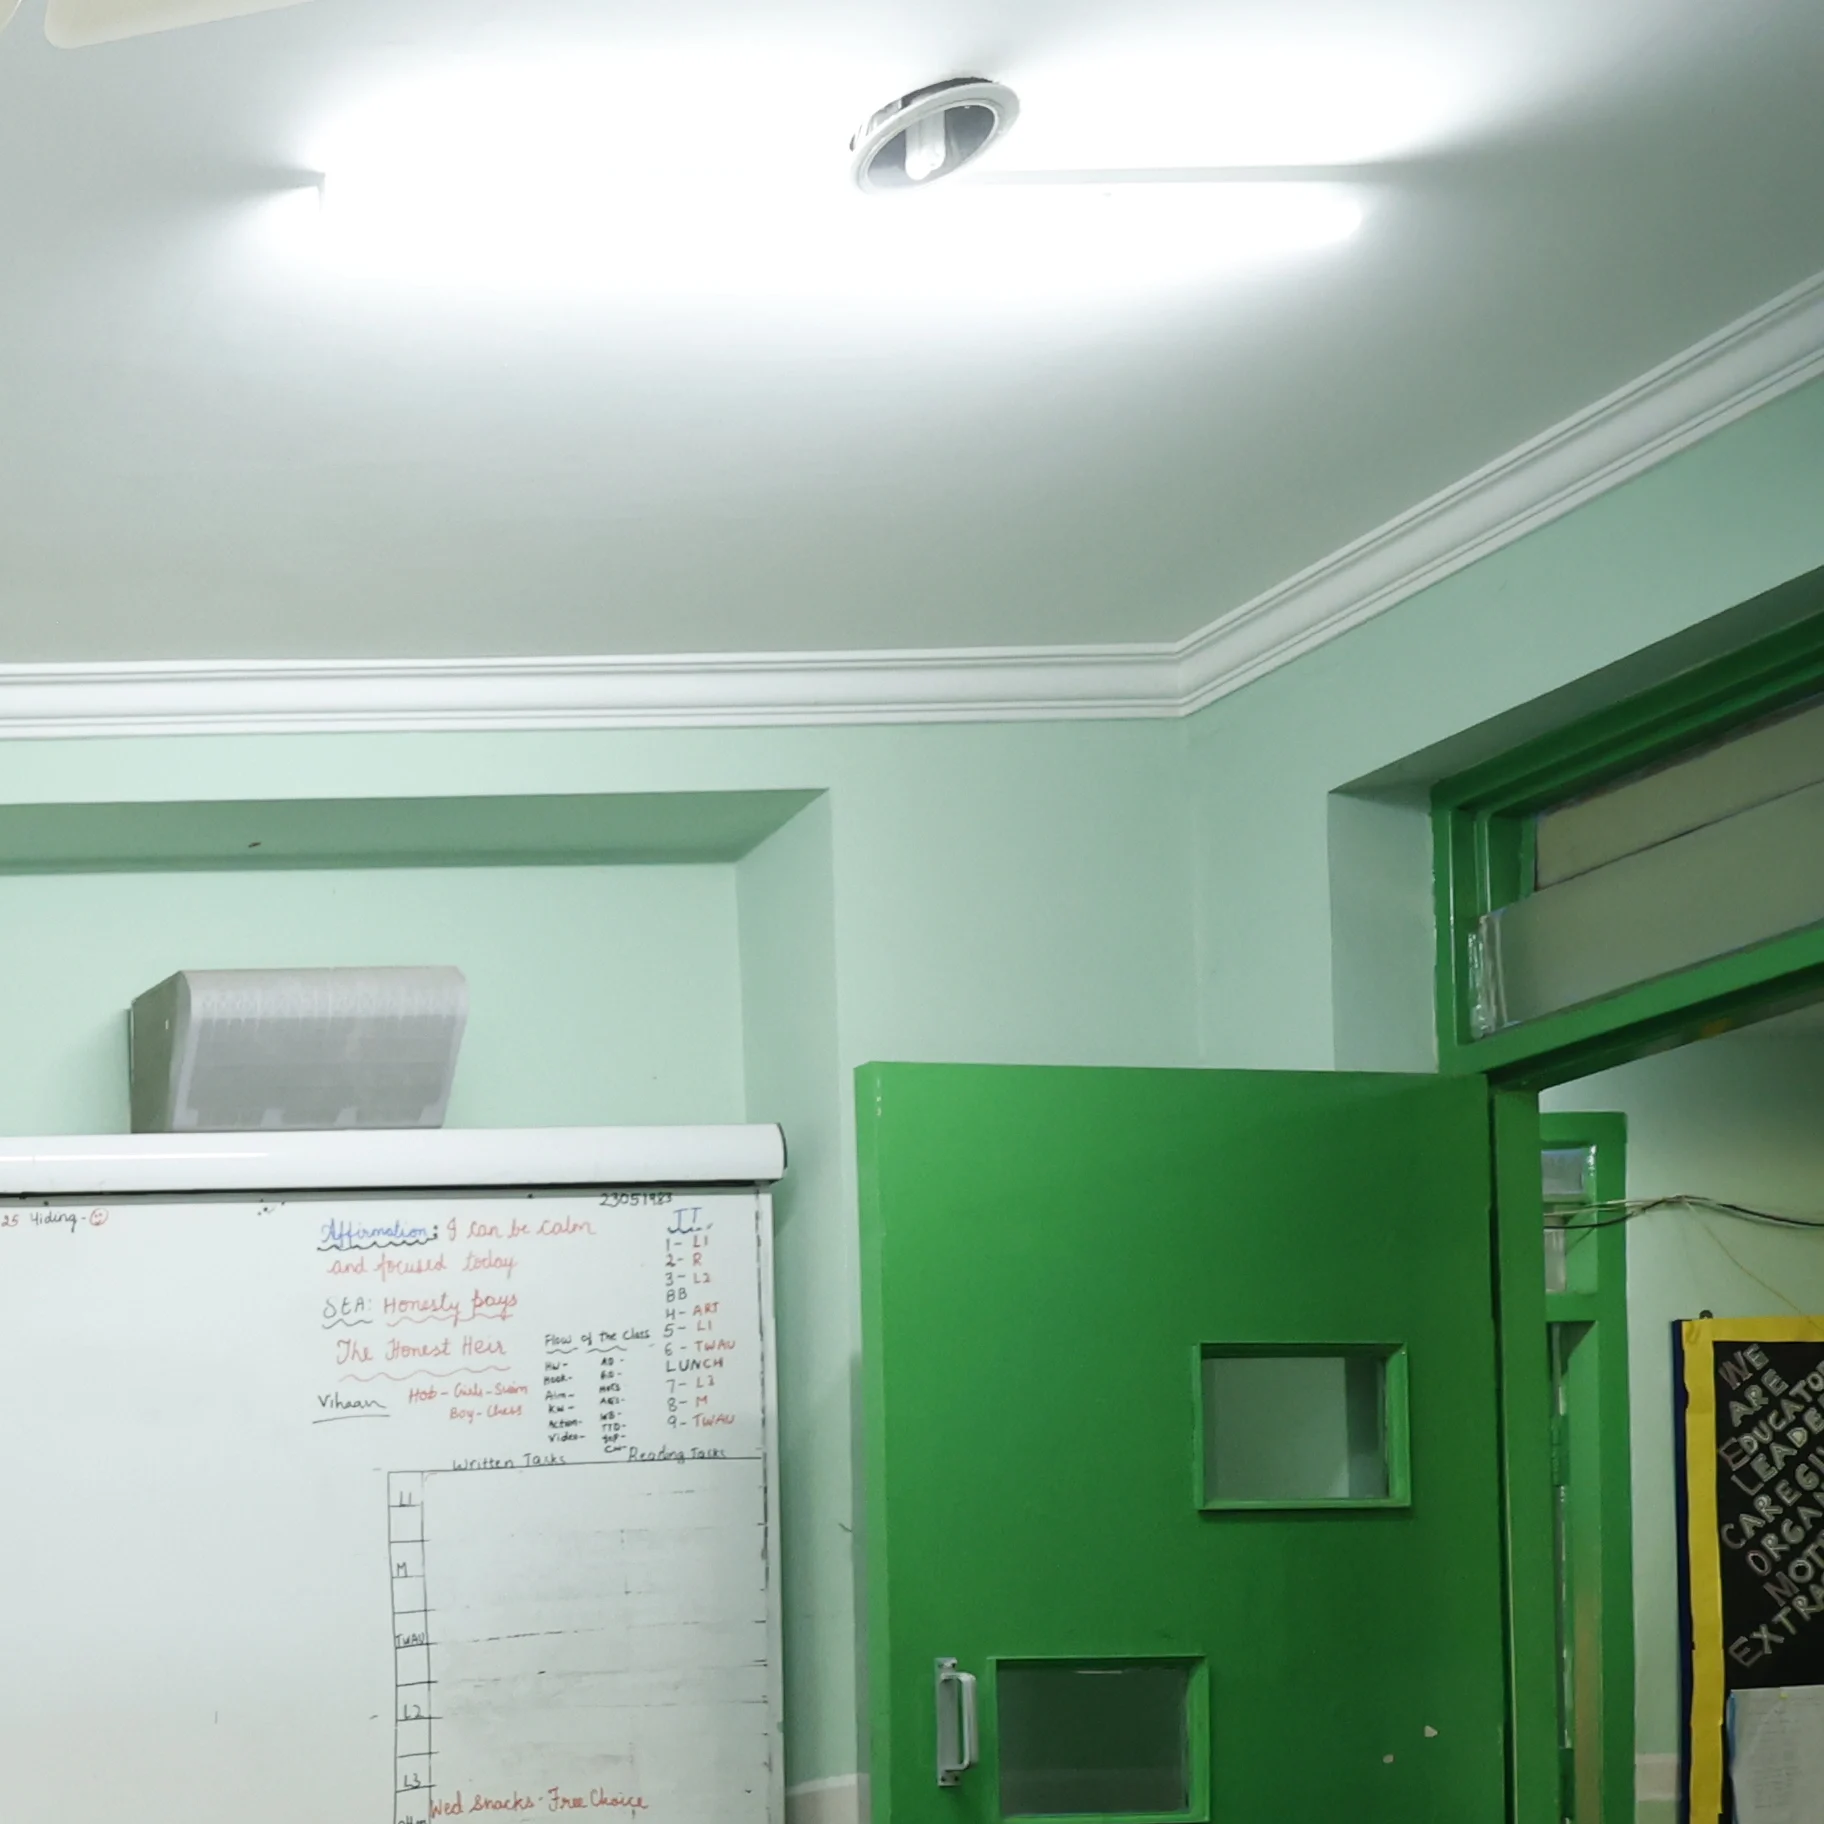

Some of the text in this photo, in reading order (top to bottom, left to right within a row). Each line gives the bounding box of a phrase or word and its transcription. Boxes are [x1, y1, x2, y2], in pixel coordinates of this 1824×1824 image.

[466, 1219, 503, 1240] can
[507, 1218, 531, 1239] be
[536, 1215, 597, 1237] calm
[326, 1249, 518, 1283] and focused today
[692, 1251, 703, 1267] R
[382, 1292, 463, 1327] Honesty
[692, 1302, 720, 1317] ART
[337, 1335, 507, 1365] The Honest Heir
[545, 1333, 572, 1347] Flow
[665, 1357, 724, 1373] LUNCH
[1718, 1343, 1770, 1391] WE
[1729, 1368, 1790, 1428] ARE
[627, 1445, 727, 1465] Reading Tasks
[1730, 1393, 1824, 1497] LEADE
[452, 1452, 567, 1472] Written Tasks
[1721, 1445, 1824, 1550] CAREGI
[1745, 1491, 1824, 1577] ORGA
[429, 1790, 464, 1819] Wed
[590, 1786, 650, 1811] Choice
